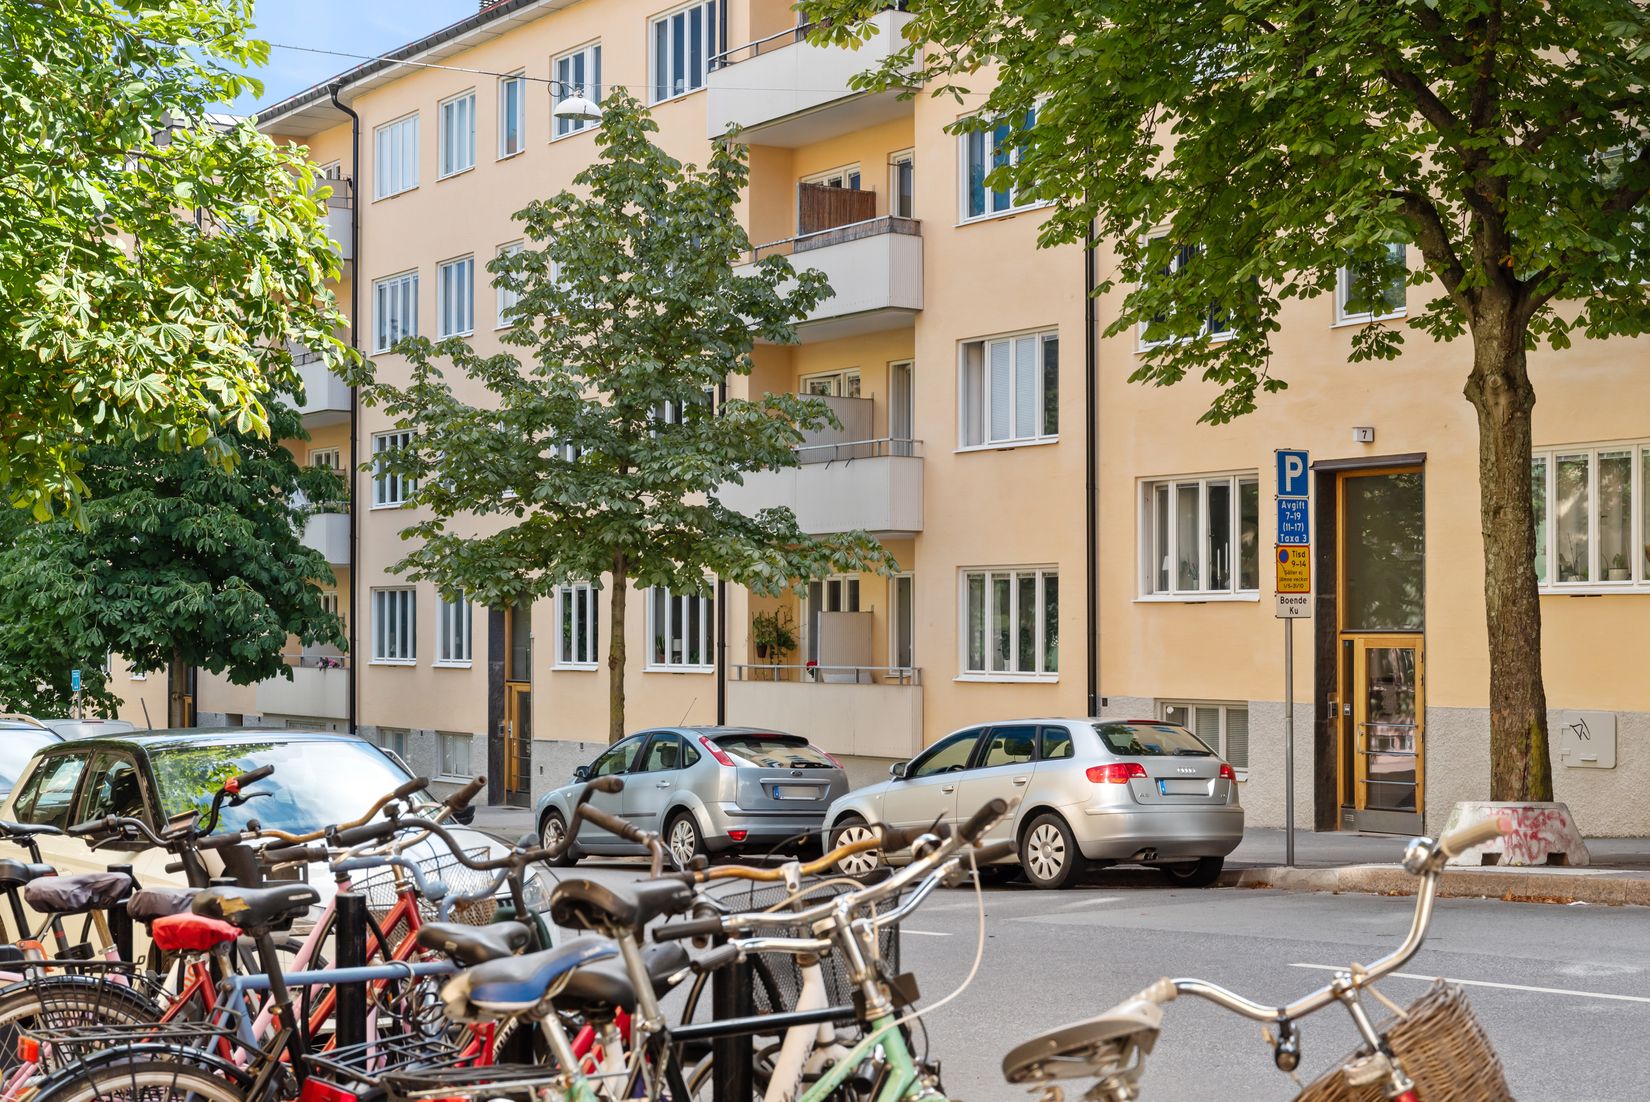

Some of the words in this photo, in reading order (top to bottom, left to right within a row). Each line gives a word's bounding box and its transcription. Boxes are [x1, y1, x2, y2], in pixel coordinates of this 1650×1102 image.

[1362, 430, 1367, 439] 7
[1285, 455, 1303, 492] P
[1281, 501, 1305, 511] Avgift
[1285, 511, 1301, 520] 7-19
[1282, 522, 1304, 532] (11-17)
[1280, 533, 1300, 543] Taxa
[1302, 534, 1307, 543] 3
[1291, 550, 1306, 558] Tisd
[1291, 560, 1307, 568] 9-14
[1280, 596, 1307, 605] Boende
[1289, 606, 1299, 615] Ku
